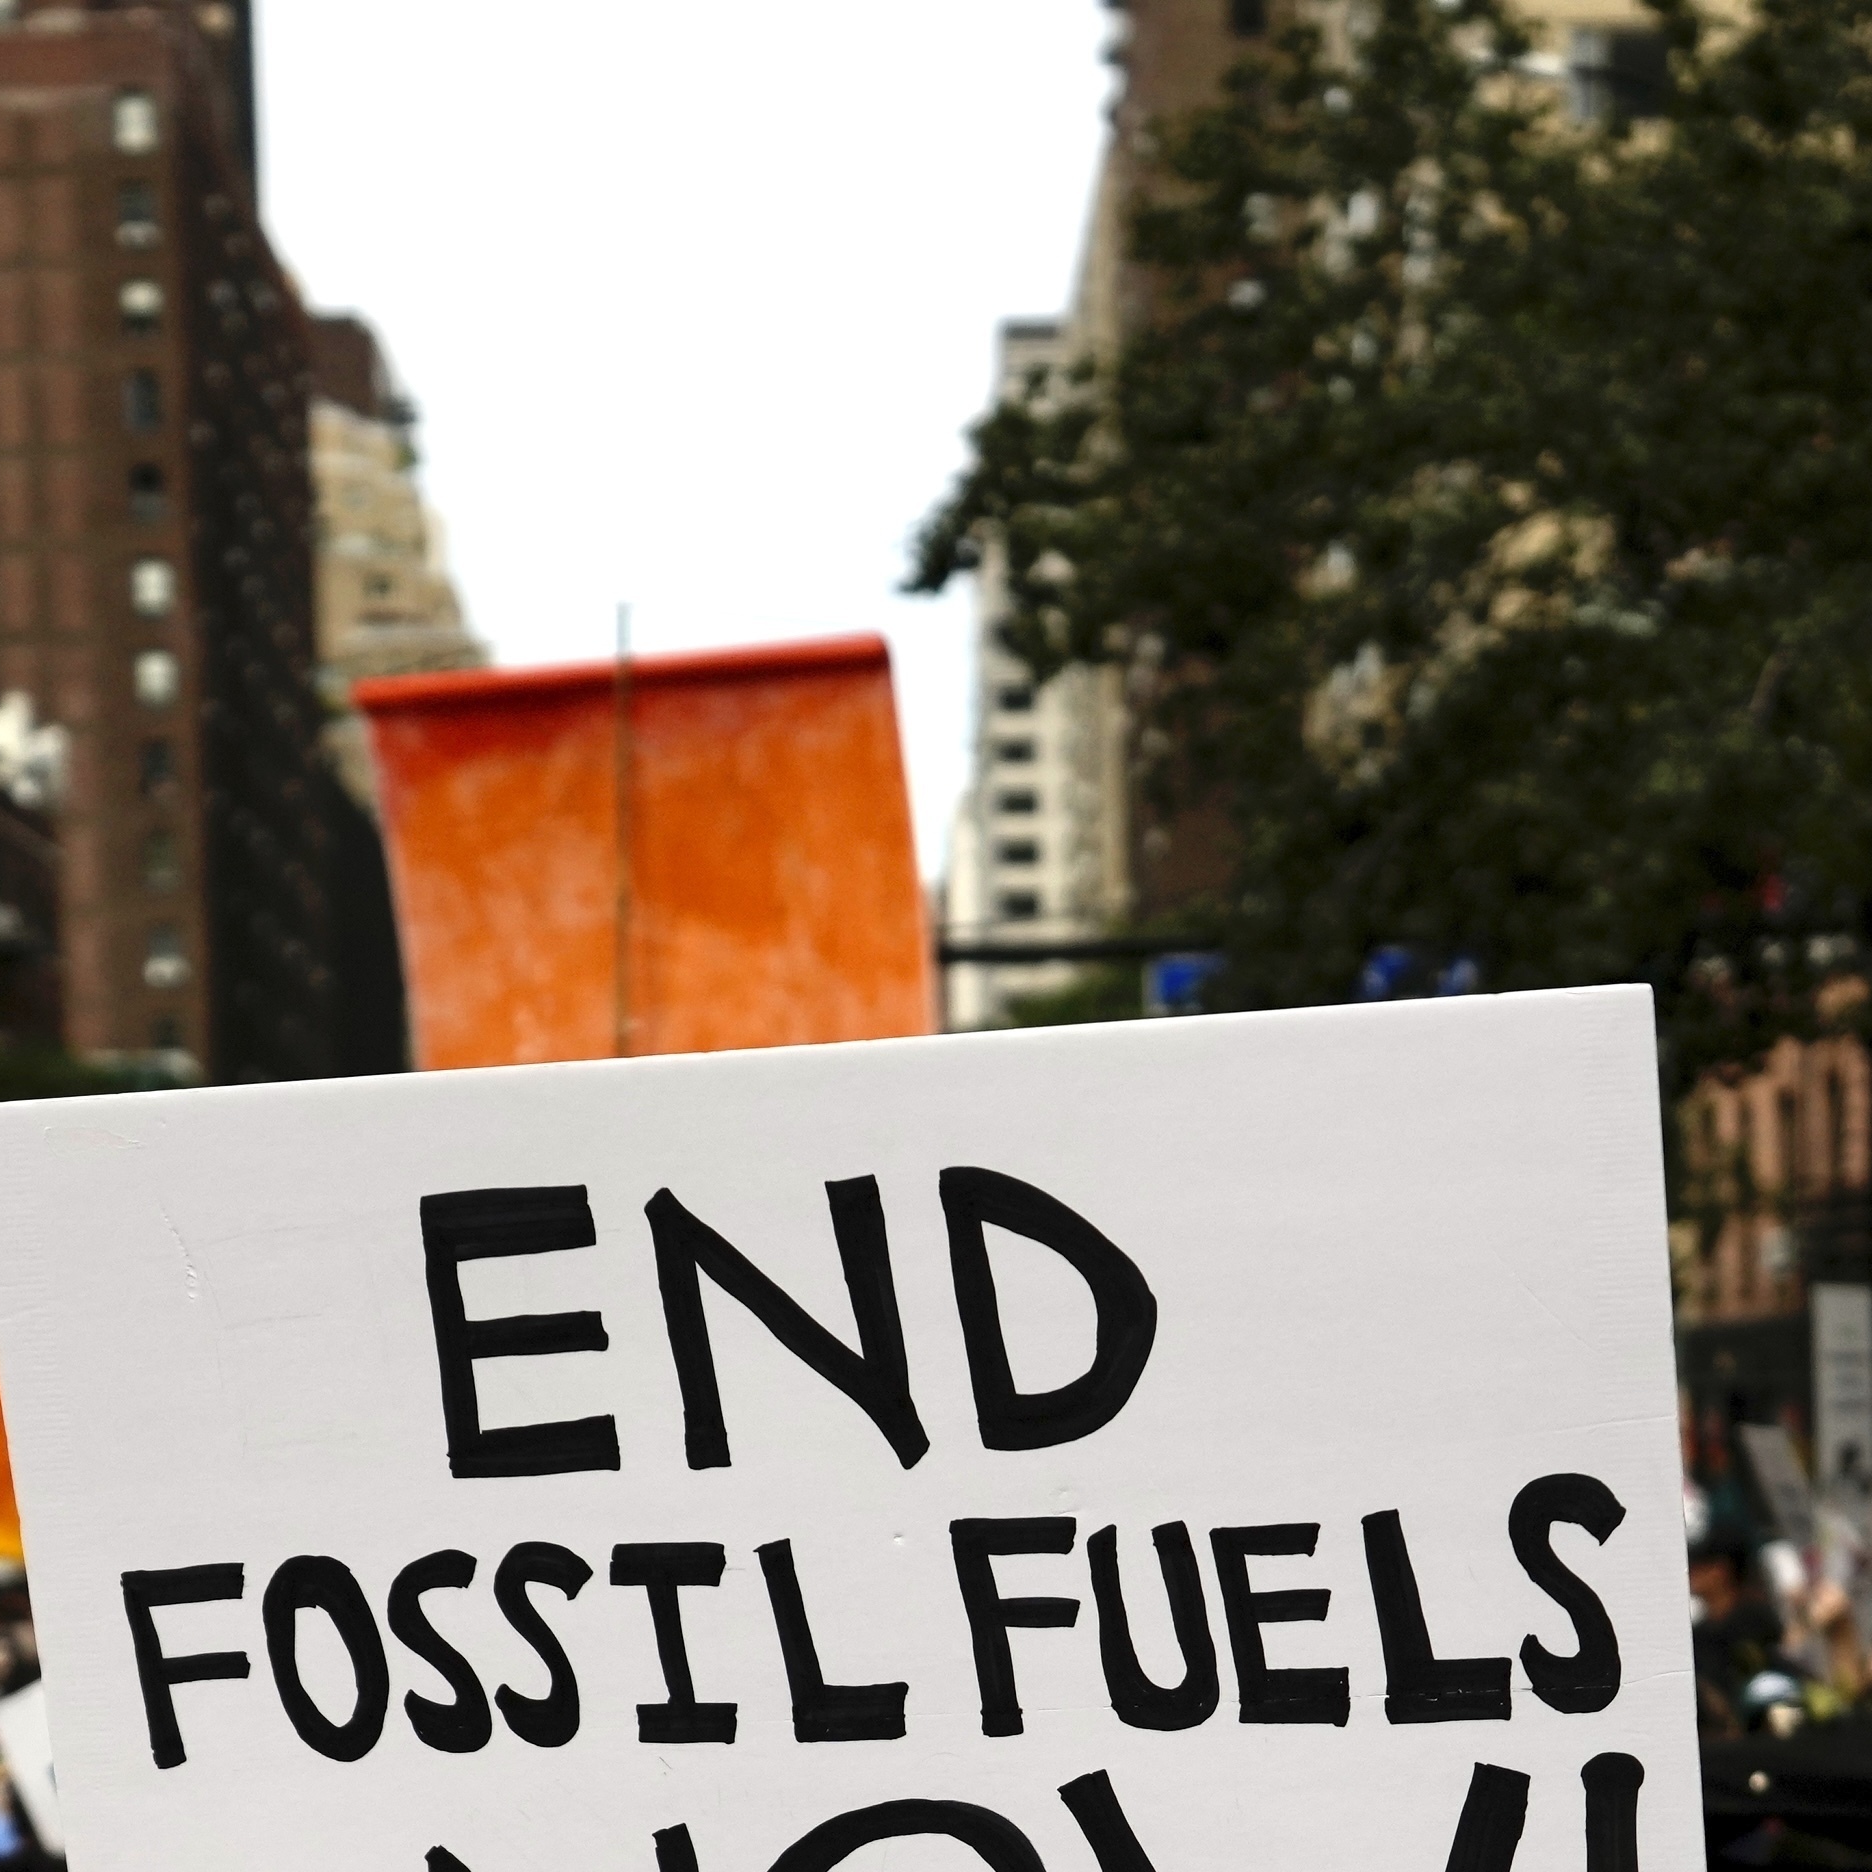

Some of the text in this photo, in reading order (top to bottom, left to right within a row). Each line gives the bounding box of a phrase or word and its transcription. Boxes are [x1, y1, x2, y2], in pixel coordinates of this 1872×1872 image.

[420, 1167, 1157, 1478] END
[121, 1473, 1626, 1769] FOSSIL FUELS
